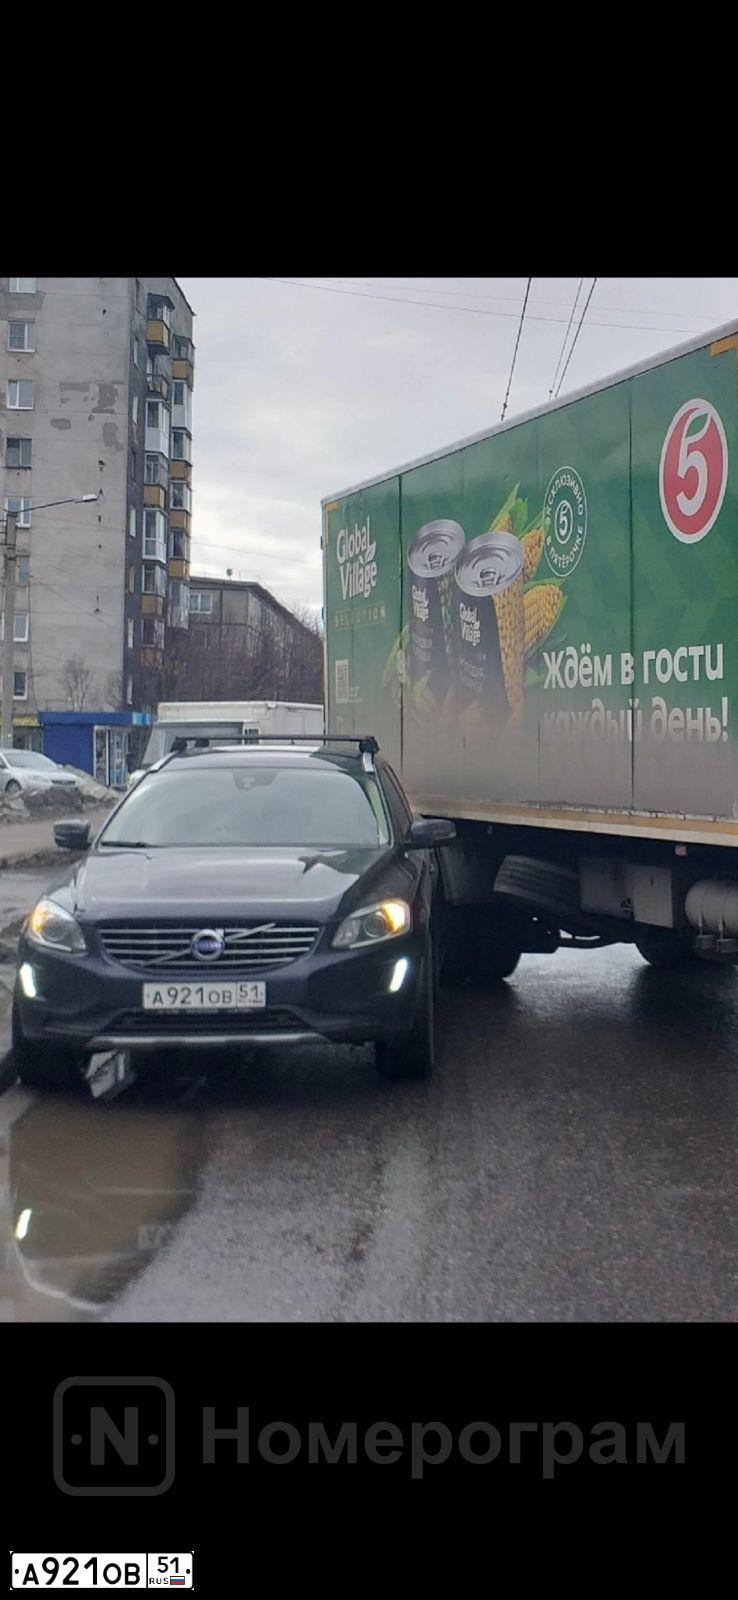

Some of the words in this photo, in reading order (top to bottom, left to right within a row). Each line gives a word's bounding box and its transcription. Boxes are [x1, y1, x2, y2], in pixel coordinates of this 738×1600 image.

[337, 515, 370, 564] Global
[339, 561, 378, 600] Village
[460, 602, 477, 624] Global
[461, 620, 481, 647] Village
[543, 643, 612, 689] Ждём
[620, 652, 635, 685] в
[643, 643, 724, 684] гости
[543, 698, 643, 742] каждый
[652, 696, 729, 743] день!
[152, 986, 233, 1005] А921ОВ
[239, 984, 260, 999] 51
